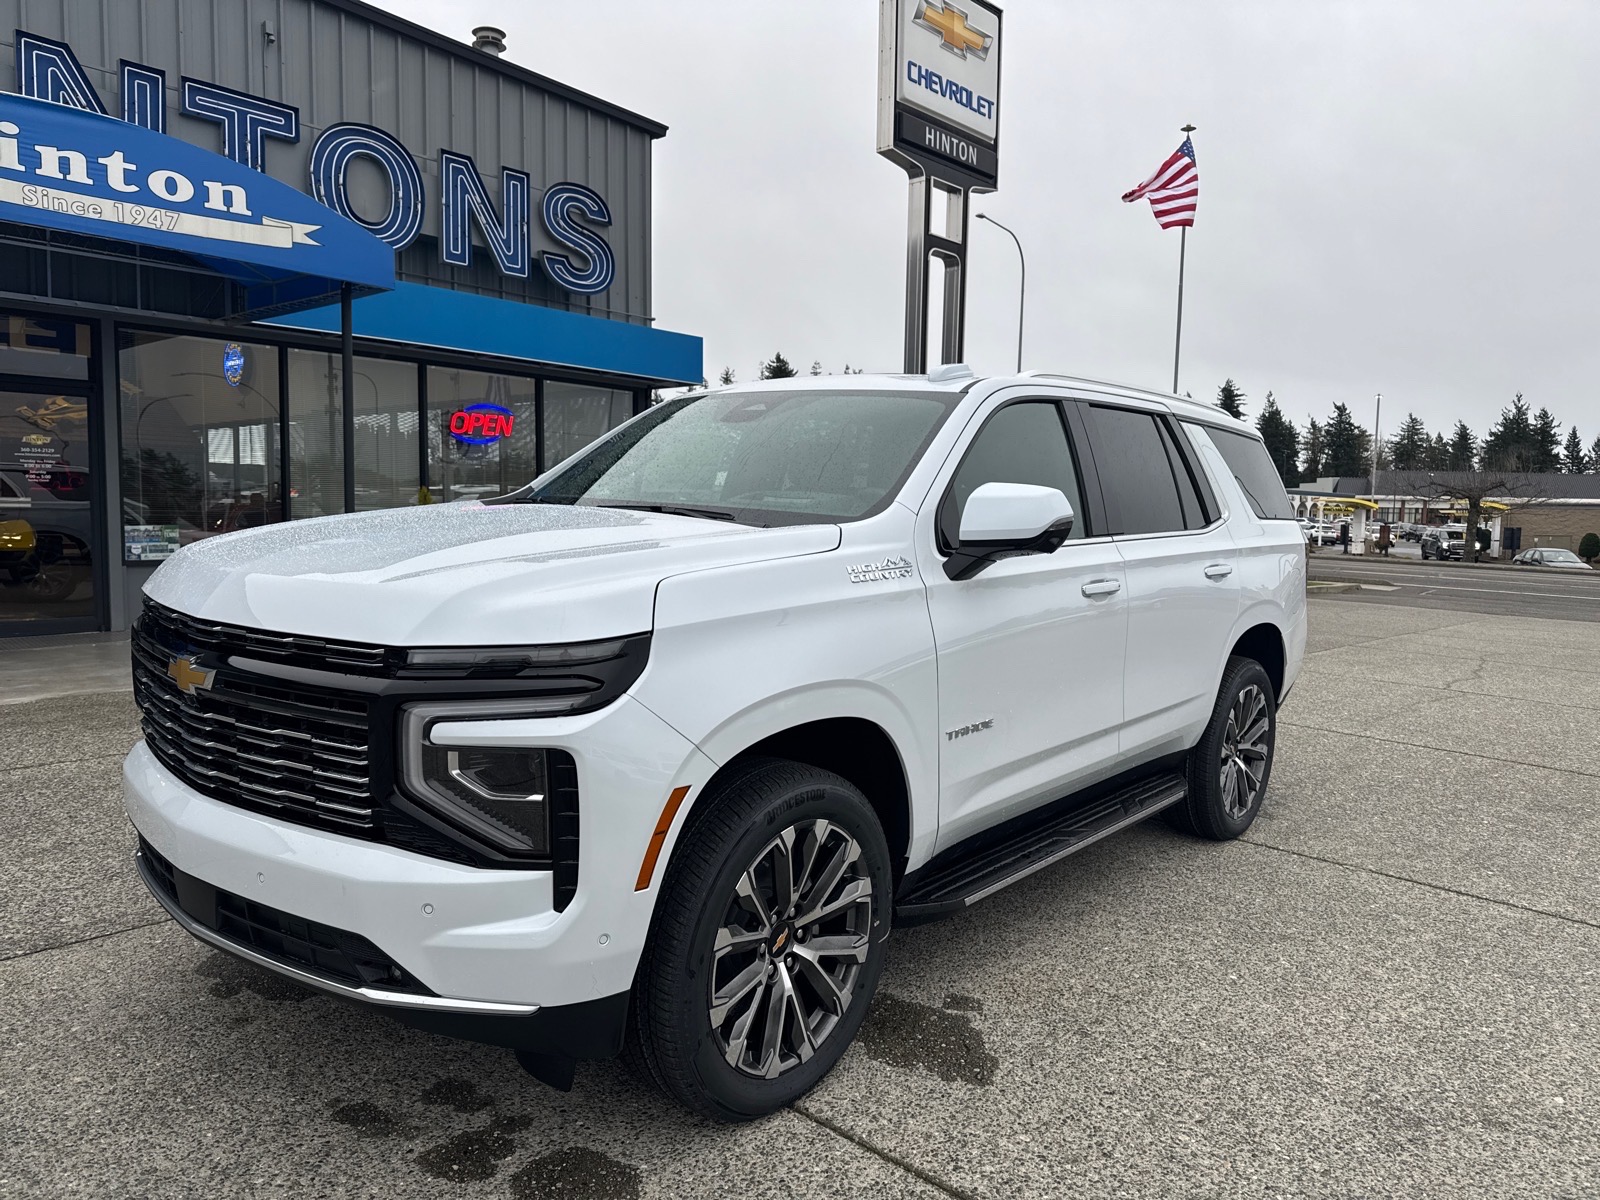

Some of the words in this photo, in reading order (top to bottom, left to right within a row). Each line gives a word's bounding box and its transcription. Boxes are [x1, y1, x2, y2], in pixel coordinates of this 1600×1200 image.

[907, 60, 994, 120] CHEVROLET
[925, 126, 977, 166] HINTON
[21, 184, 103, 219] Since
[113, 202, 181, 231] 1947
[450, 411, 514, 437] OPEN
[846, 563, 881, 575] HIGH
[850, 568, 913, 583] COUNTRY
[945, 718, 994, 741] TAHOE
